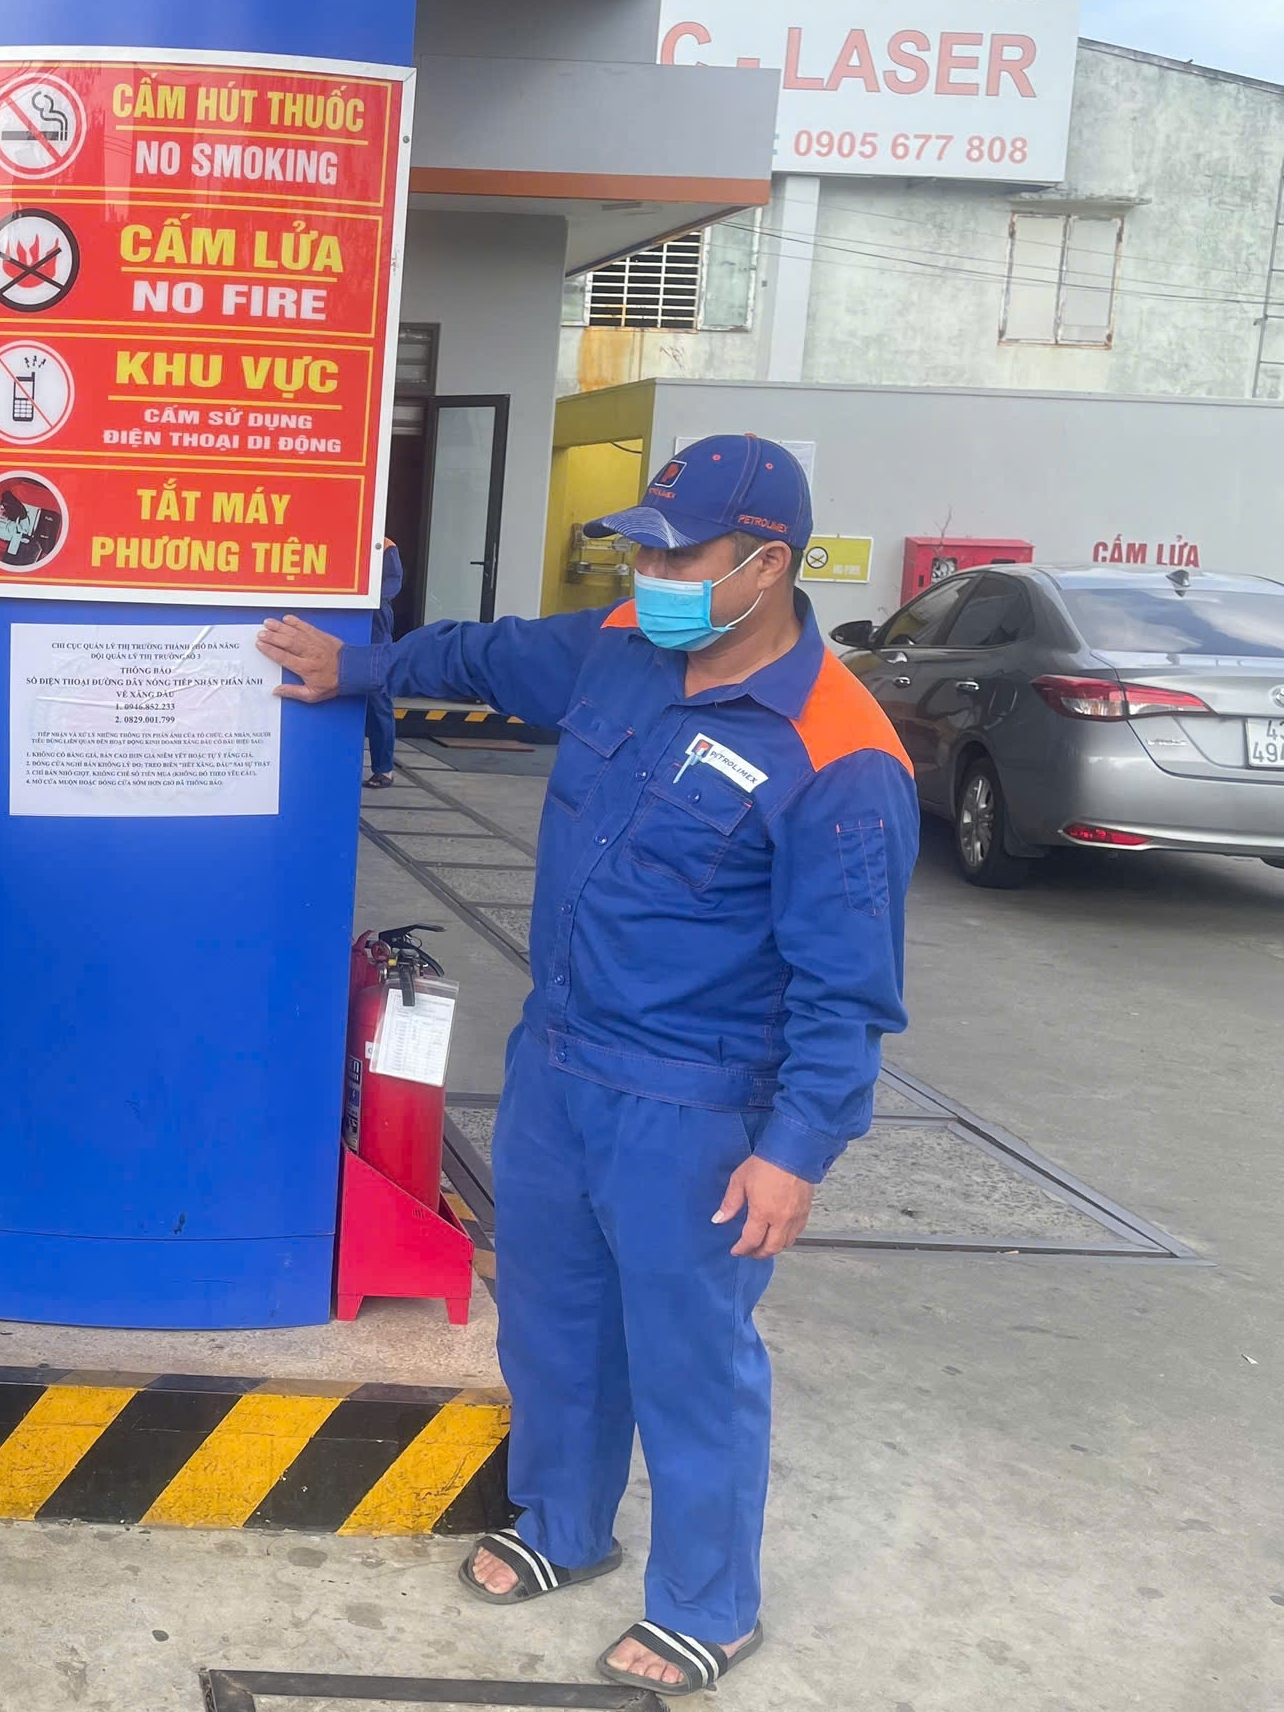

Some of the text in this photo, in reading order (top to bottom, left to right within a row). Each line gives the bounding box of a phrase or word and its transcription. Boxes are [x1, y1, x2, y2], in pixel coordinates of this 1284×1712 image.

[783, 27, 1038, 98] LASER
[112, 75, 365, 131] CẤM HÚT THUỐC
[136, 140, 339, 186] NO SMOKING
[793, 129, 1029, 165] 0905 677 808
[120, 213, 344, 273] CẤM LỬA
[133, 281, 327, 320] NO FIRE
[116, 350, 340, 399] KHU VỰC
[103, 427, 342, 456] ĐIỆN THOẠI DI ĐỘNG
[144, 407, 313, 431] CẤM SỬ DỤNG
[136, 477, 291, 525] TẮT MÁY
[91, 536, 328, 581] PHƯƠNG TIỆN
[1092, 533, 1200, 568] CẤM LỬA
